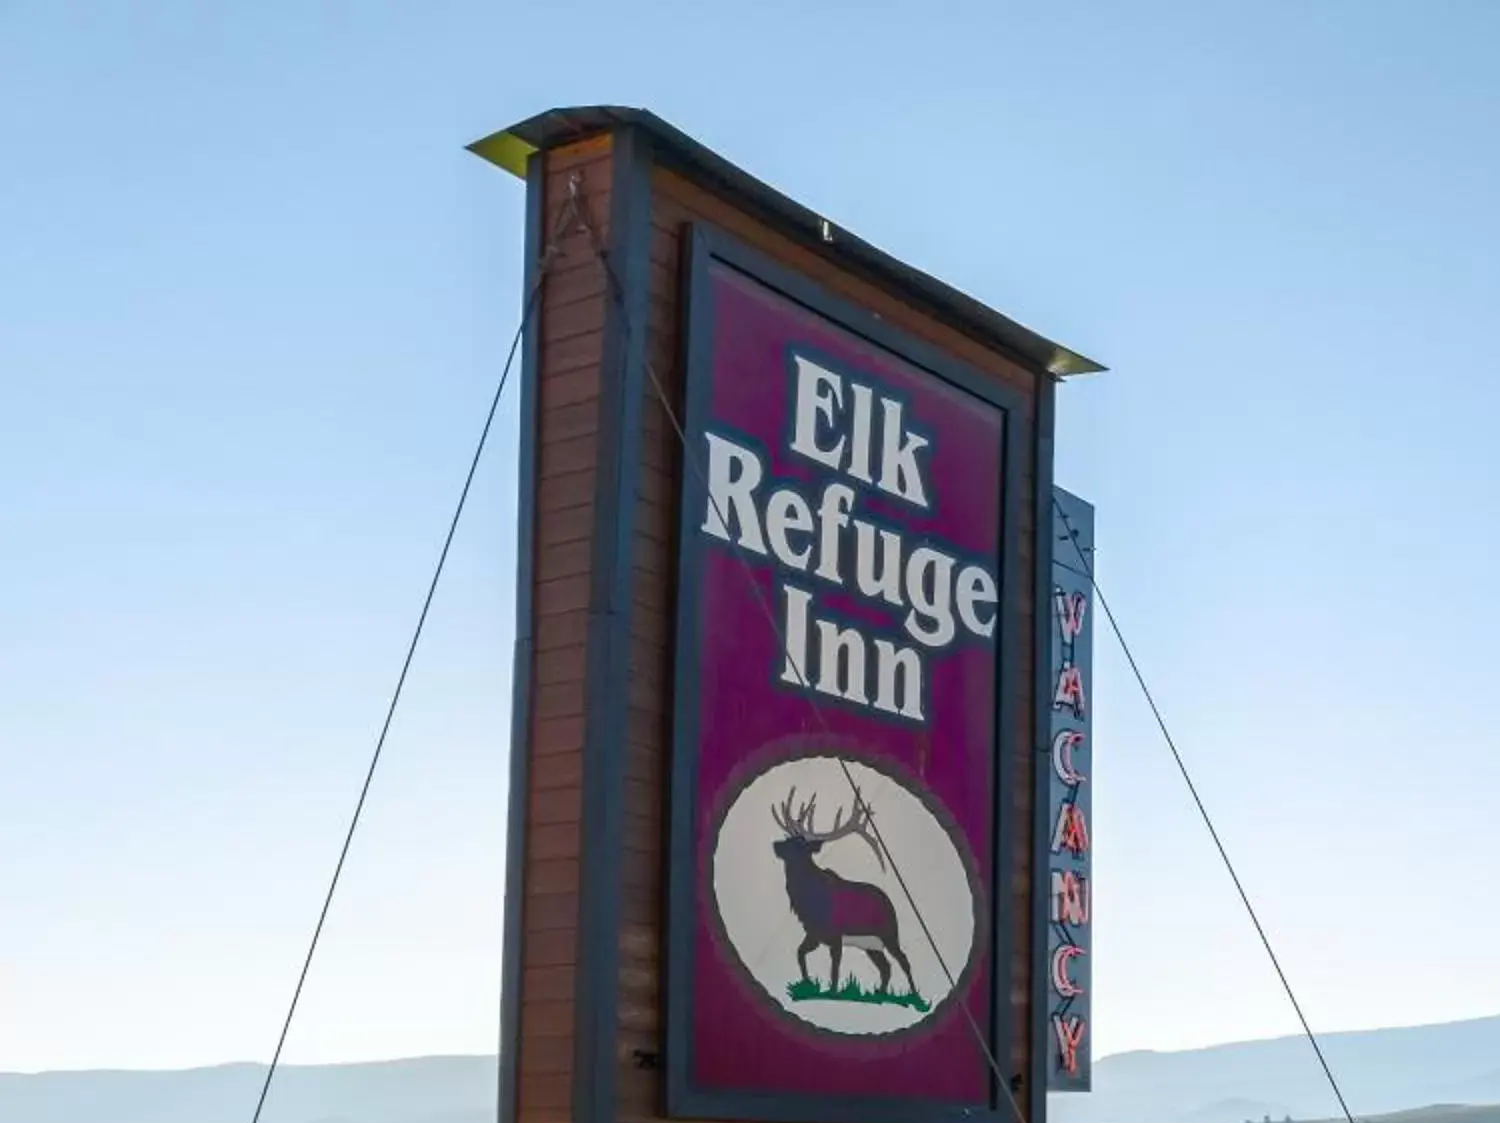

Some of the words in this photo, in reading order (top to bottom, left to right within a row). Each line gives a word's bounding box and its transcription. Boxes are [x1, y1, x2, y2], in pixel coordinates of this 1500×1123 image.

[790, 354, 928, 507] Elk
[702, 432, 998, 646] Refuge
[781, 584, 924, 720] Inn
[1051, 588, 1090, 1074] VACANCY
